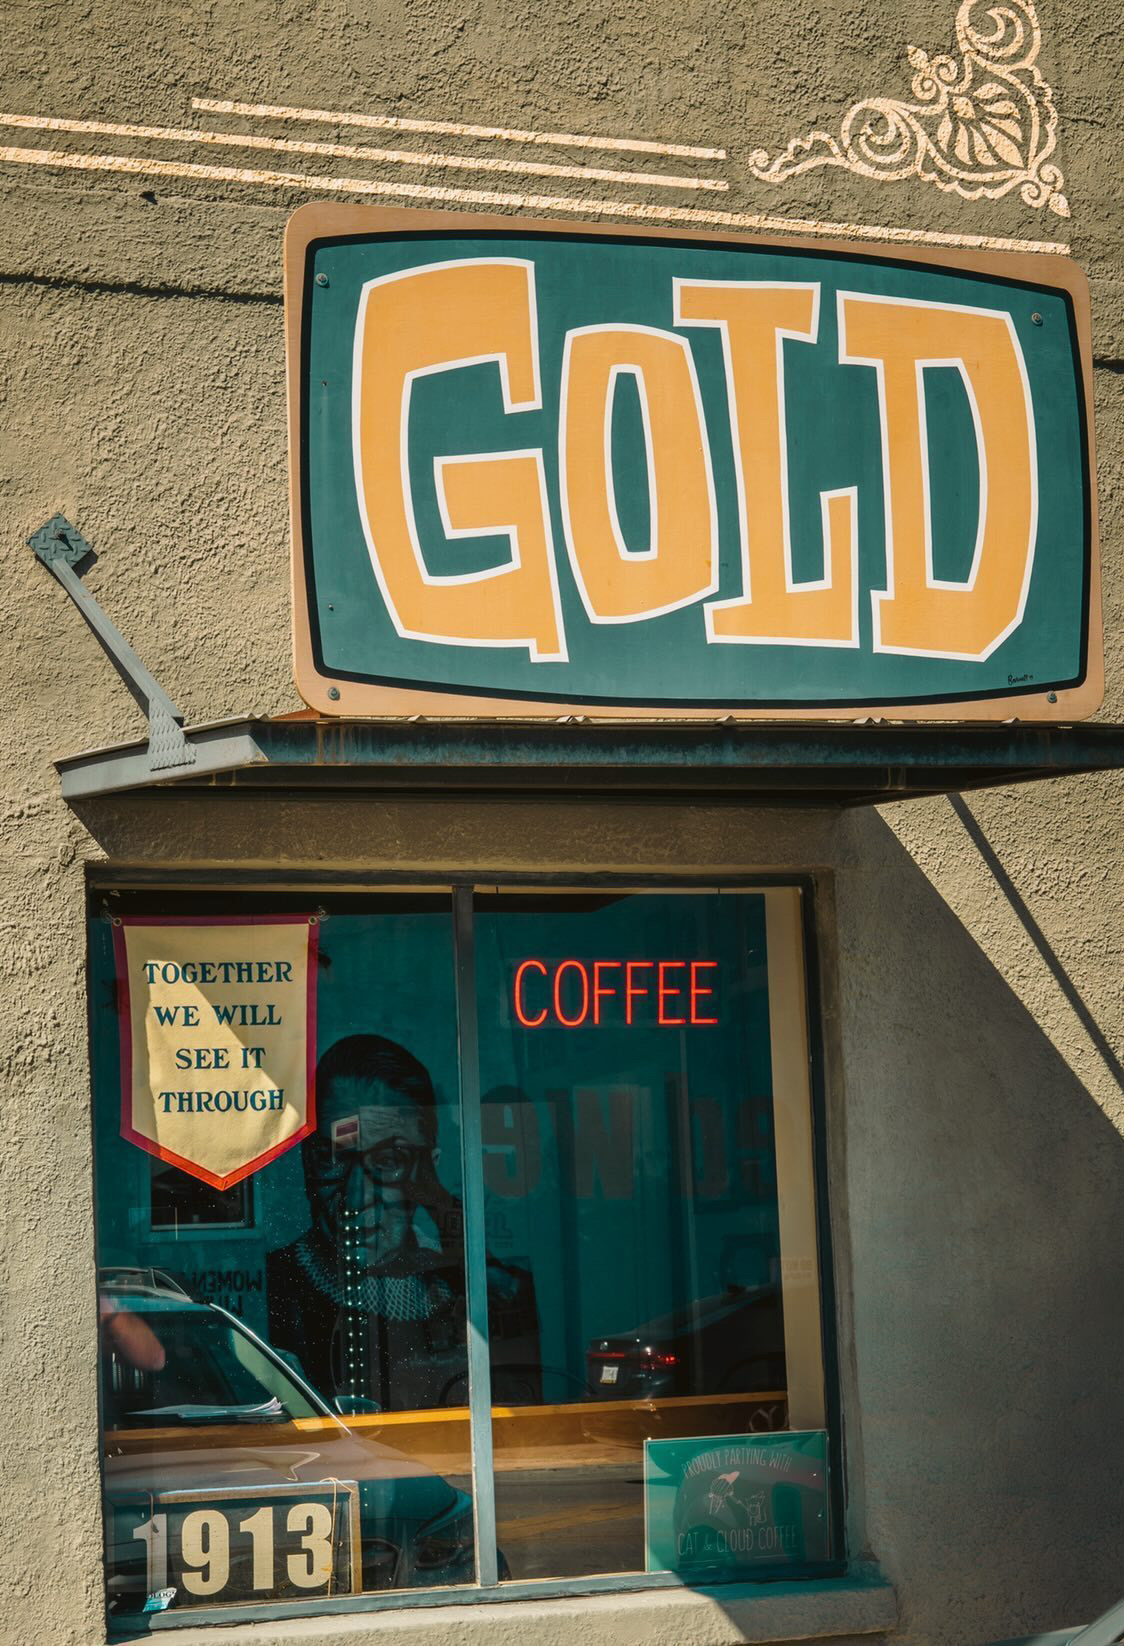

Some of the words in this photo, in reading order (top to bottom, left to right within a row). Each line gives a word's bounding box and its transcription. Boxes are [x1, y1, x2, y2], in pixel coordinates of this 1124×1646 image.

[352, 257, 1039, 663] GOLD
[142, 961, 293, 984] TOGETHER
[513, 959, 719, 1028] COFFEE
[153, 1005, 201, 1027] WE
[212, 1004, 282, 1026] WILL
[175, 1047, 230, 1070] SEE
[241, 1046, 266, 1069] IT
[158, 1089, 285, 1113] THROUGH
[681, 1451, 721, 1479] PROUDLY
[725, 1447, 766, 1467] PARTYING
[766, 1452, 793, 1474] WITH
[133, 1502, 332, 1596] 1913
[677, 1530, 698, 1556] CAT
[716, 1527, 753, 1553] CLOUD
[758, 1524, 798, 1551] COFFEE
